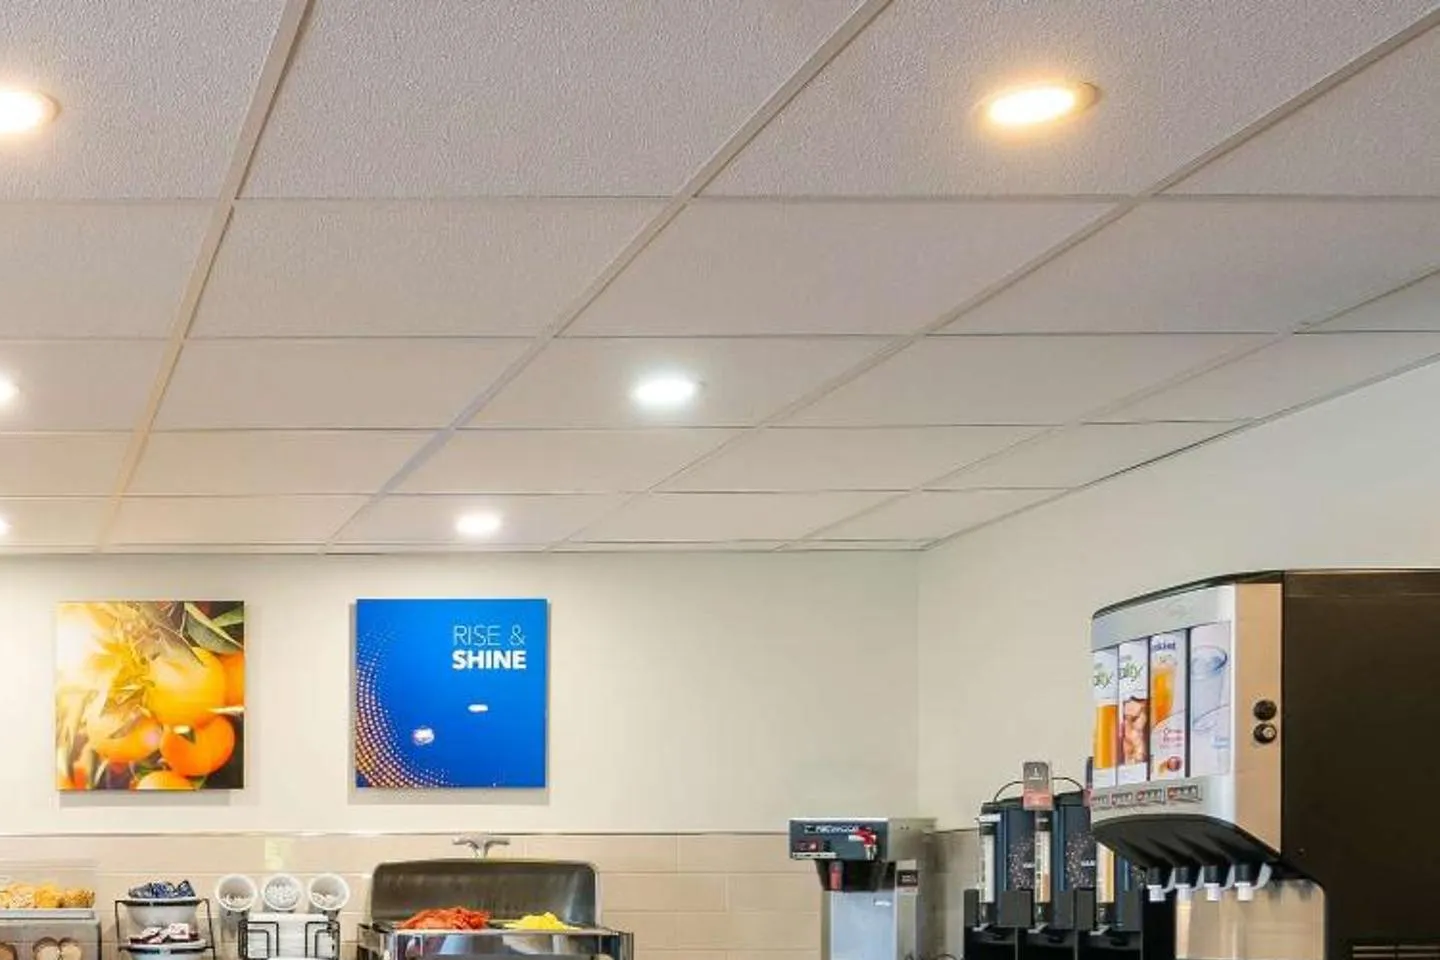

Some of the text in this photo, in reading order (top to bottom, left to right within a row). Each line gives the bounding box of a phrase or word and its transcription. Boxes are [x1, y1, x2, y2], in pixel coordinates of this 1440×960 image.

[453, 624, 526, 647] RISE &
[452, 649, 527, 670] SHINE
